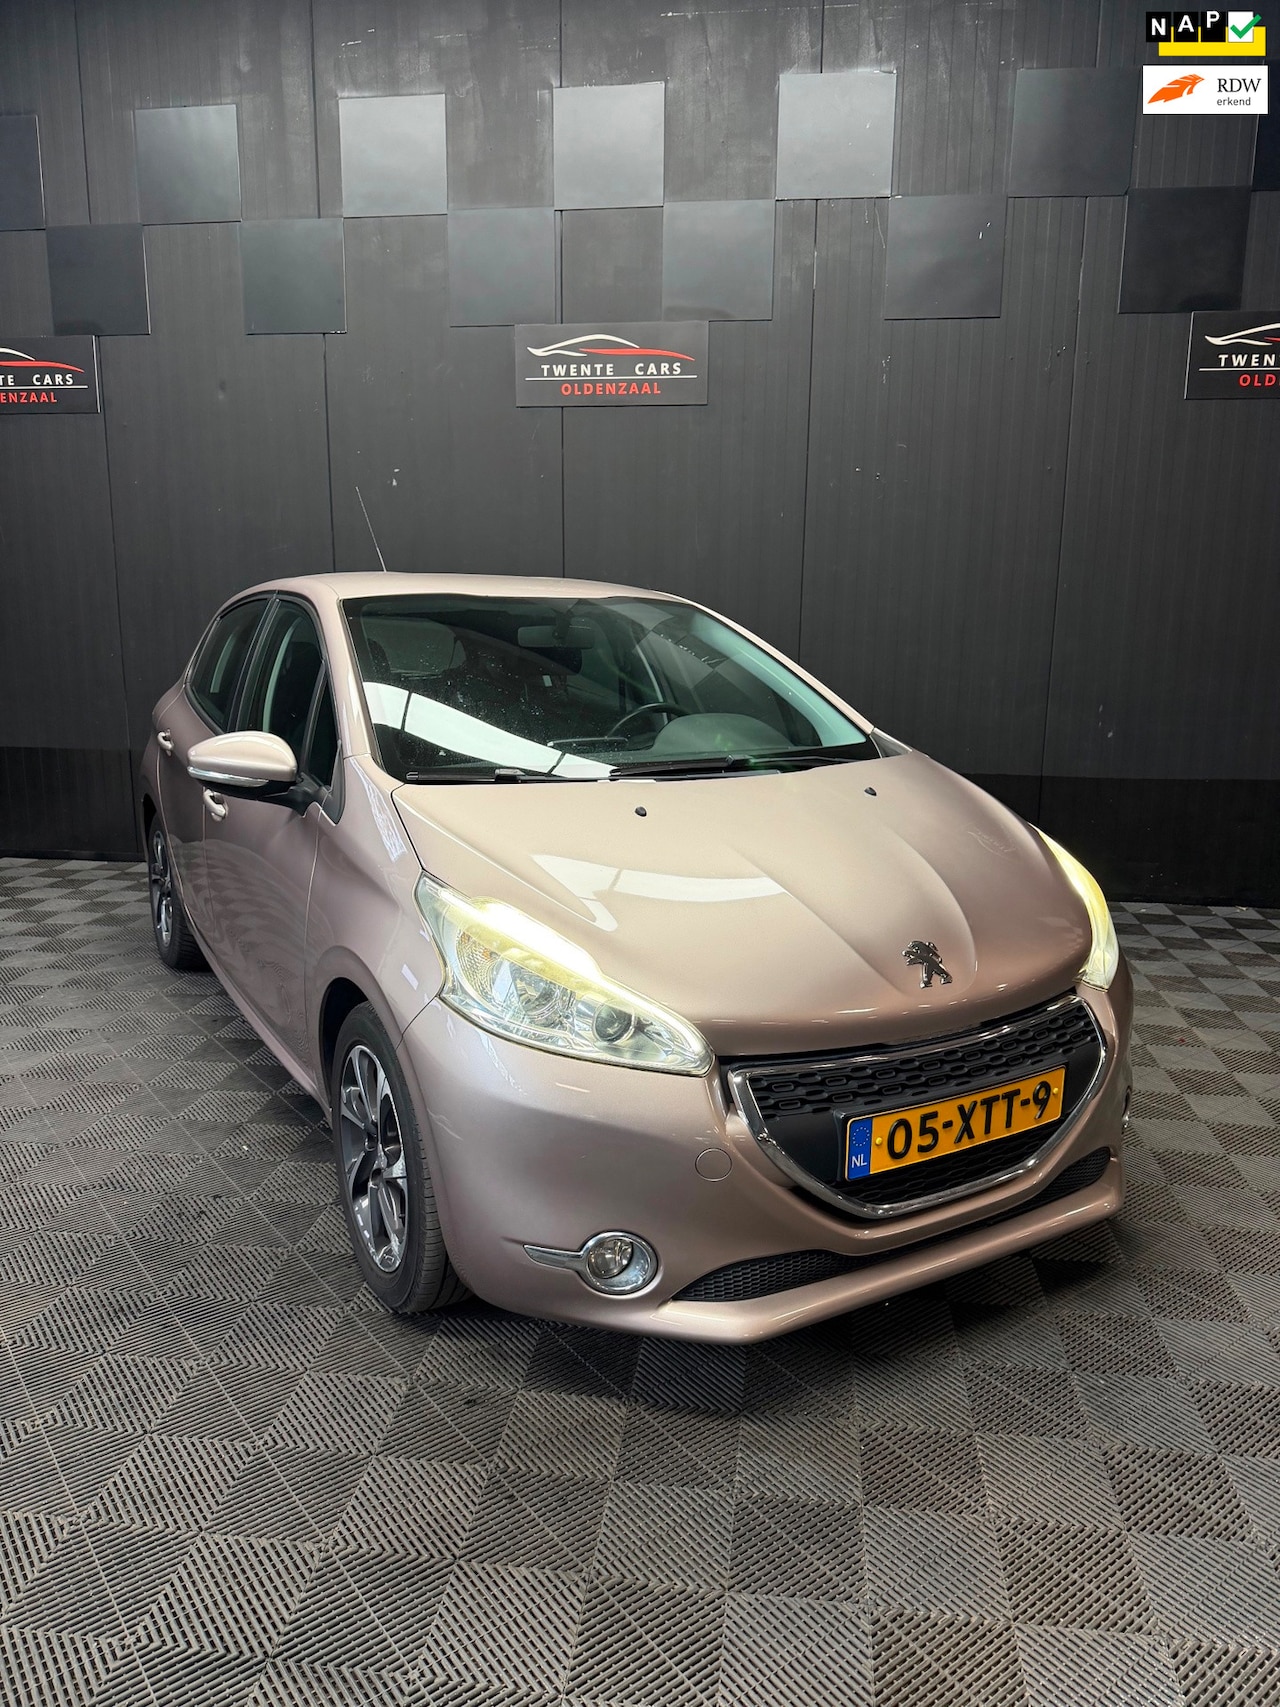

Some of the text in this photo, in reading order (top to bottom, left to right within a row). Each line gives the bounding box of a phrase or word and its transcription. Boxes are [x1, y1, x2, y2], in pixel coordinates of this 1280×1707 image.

[1218, 354, 1280, 367] TWEN
[541, 362, 682, 377] TWENTE CARS
[32, 374, 74, 385] CARS
[1239, 373, 1280, 387] OLD
[561, 382, 661, 396] OLDENZAAL
[886, 1080, 1051, 1160] 05-XTT-9
[851, 1153, 867, 1169] NL
